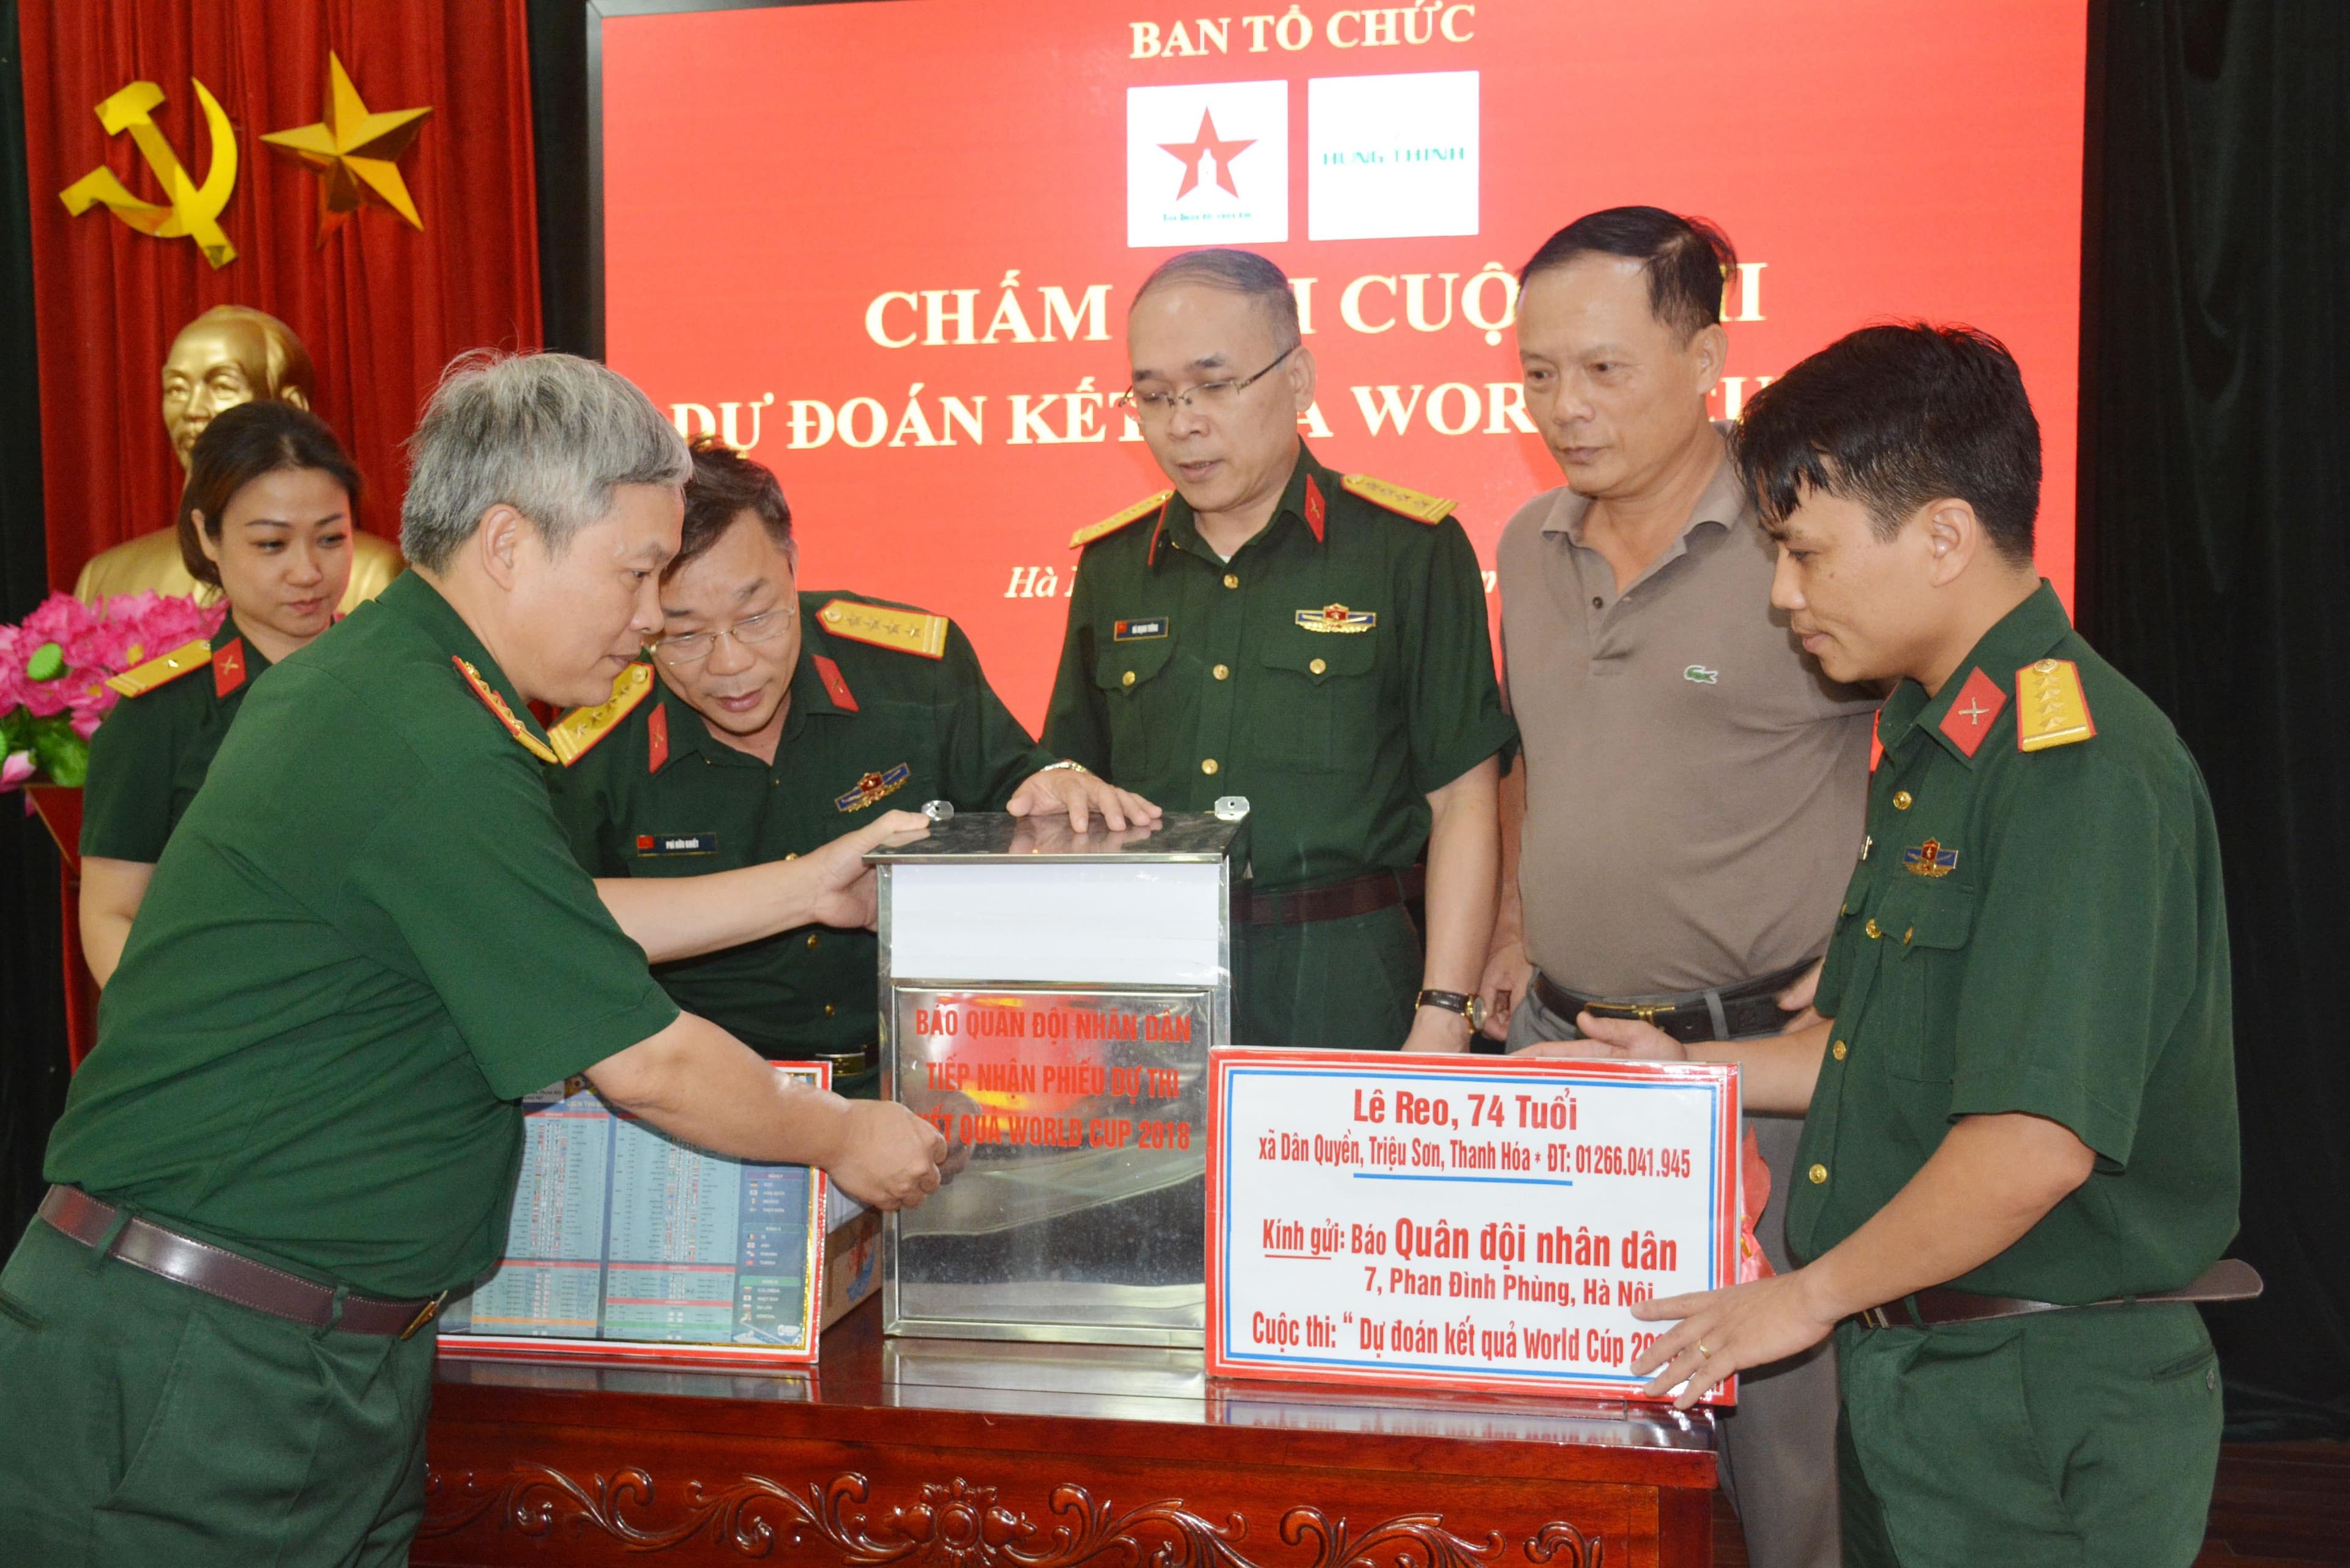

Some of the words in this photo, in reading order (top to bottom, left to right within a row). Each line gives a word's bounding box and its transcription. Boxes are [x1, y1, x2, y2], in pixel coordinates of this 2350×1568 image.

[1129, 17, 1231, 59] BAN
[1242, 4, 1313, 53] TỔ
[1326, 0, 1475, 48] CHỨC
[865, 270, 1113, 348] CHẤM
[1340, 262, 1519, 346] CUỘ
[786, 383, 987, 450] ĐOÁN
[1350, 383, 1539, 436] WOR
[1004, 566, 1058, 598] Hà
[966, 1007, 1025, 1039] QUÂN
[1032, 1007, 1068, 1045] ĐỘI
[1076, 1008, 1138, 1042] NHÂN
[1145, 1009, 1191, 1043] DÂN
[926, 1053, 970, 1091] TIẾP
[977, 1058, 1035, 1099] NHẬN
[1042, 1058, 1105, 1096] PHIẾU
[1111, 1064, 1143, 1104] DỰ
[1146, 1067, 1179, 1098] THI
[918, 1102, 954, 1142] ẾT
[1009, 1115, 1083, 1148] WORLD
[1089, 1118, 1132, 1149] CUP
[1138, 1119, 1190, 1151] 2018
[1354, 1089, 1385, 1123] Lê
[1395, 1091, 1458, 1130] Reo,
[1468, 1094, 1505, 1127] 74
[1515, 1088, 1577, 1130] Tuổi
[1259, 1129, 1276, 1160] xã
[1281, 1132, 1309, 1162] Dân
[1314, 1129, 1364, 1168] Quyền,
[1368, 1135, 1407, 1171] Triệu
[1411, 1137, 1445, 1171] Sơn,
[1450, 1139, 1496, 1170] Thanh
[1501, 1141, 1531, 1171] Hóa
[1547, 1143, 1571, 1173] ĐT:
[1575, 1144, 1691, 1179] 01266.041.945
[1263, 1219, 1305, 1250] Kính
[1310, 1218, 1345, 1256] gửi:
[1351, 1223, 1387, 1256] Báo
[1395, 1217, 1469, 1261] Quân
[1480, 1222, 1526, 1271] đội
[1537, 1225, 1611, 1267] nhân
[1621, 1230, 1677, 1272] dân
[1364, 1266, 1382, 1296] 7,
[1390, 1267, 1442, 1296] Phan
[1449, 1271, 1496, 1300] Đình
[1503, 1274, 1576, 1307] Phùng,
[1583, 1278, 1610, 1307] Hà
[1253, 1310, 1300, 1353] Cuộc
[1306, 1315, 1337, 1349] thi:
[1360, 1317, 1386, 1358] Dự
[1391, 1319, 1438, 1354] đoán
[1445, 1315, 1475, 1357] kết
[1482, 1320, 1518, 1362] quả
[1523, 1327, 1580, 1362] World
[1587, 1328, 1624, 1368] Cúp
